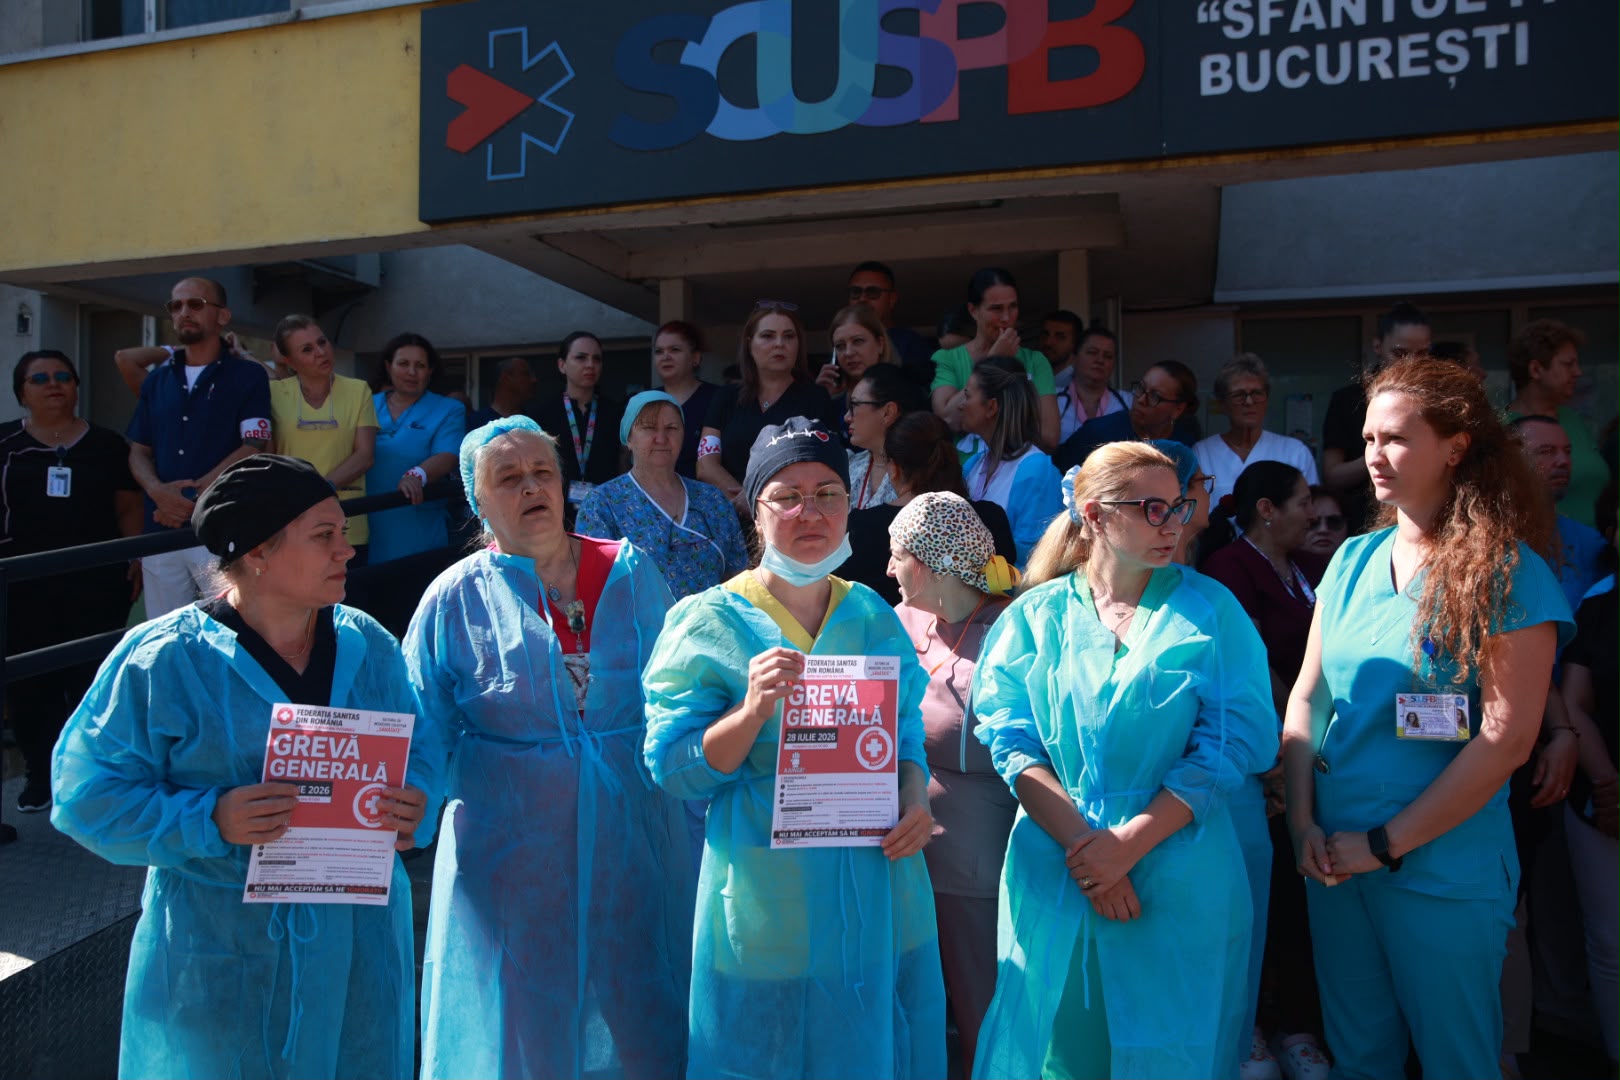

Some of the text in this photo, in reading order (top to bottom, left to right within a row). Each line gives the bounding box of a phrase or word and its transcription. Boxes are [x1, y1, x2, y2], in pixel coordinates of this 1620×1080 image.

[1200, 21, 1529, 96] BUCUREȘTI
[606, 0, 1146, 152] SCUSPB
[789, 681, 859, 706] GREVĂ
[332, 710, 360, 721] SANITAS
[786, 705, 883, 726] GENERALĂ
[273, 733, 361, 760] GREVĂ
[786, 732, 836, 742] 28 IULIE 2026
[270, 759, 388, 783] GENERALĂ
[308, 785, 331, 795] 2026
